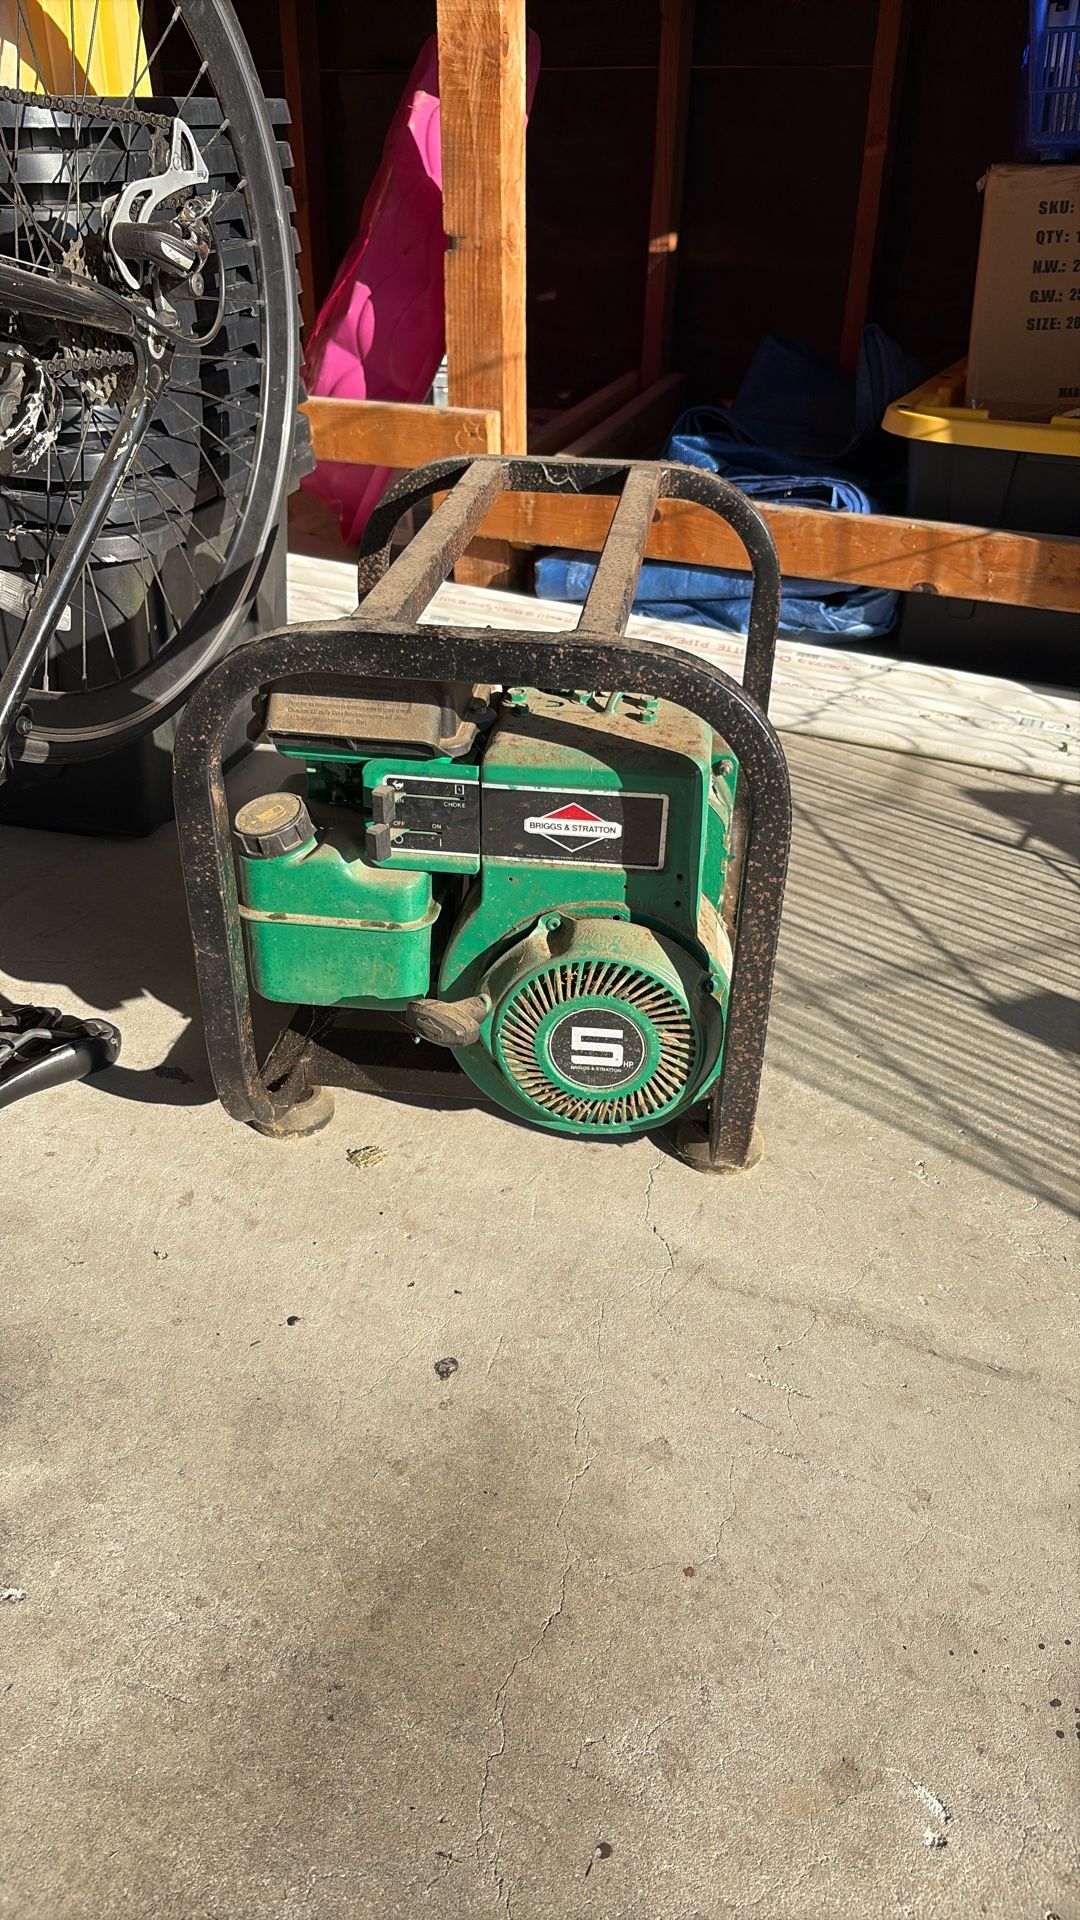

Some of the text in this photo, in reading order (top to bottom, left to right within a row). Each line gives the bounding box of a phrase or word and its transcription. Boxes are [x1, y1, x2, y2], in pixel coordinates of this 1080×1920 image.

[1038, 200, 1074, 215] SKU:
[1036, 231, 1069, 246] QTY:
[1032, 260, 1066, 274] N.W.:
[1029, 290, 1063, 303] G.W.:
[1026, 317, 1061, 331] SIZE:
[443, 800, 467, 809] CHOKE
[392, 819, 407, 827] OFF
[431, 822, 443, 830] ON
[529, 822, 563, 831] BRIGGS
[571, 824, 617, 834] STRATTON
[571, 1027, 623, 1066] 5
[623, 1061, 634, 1069] HP
